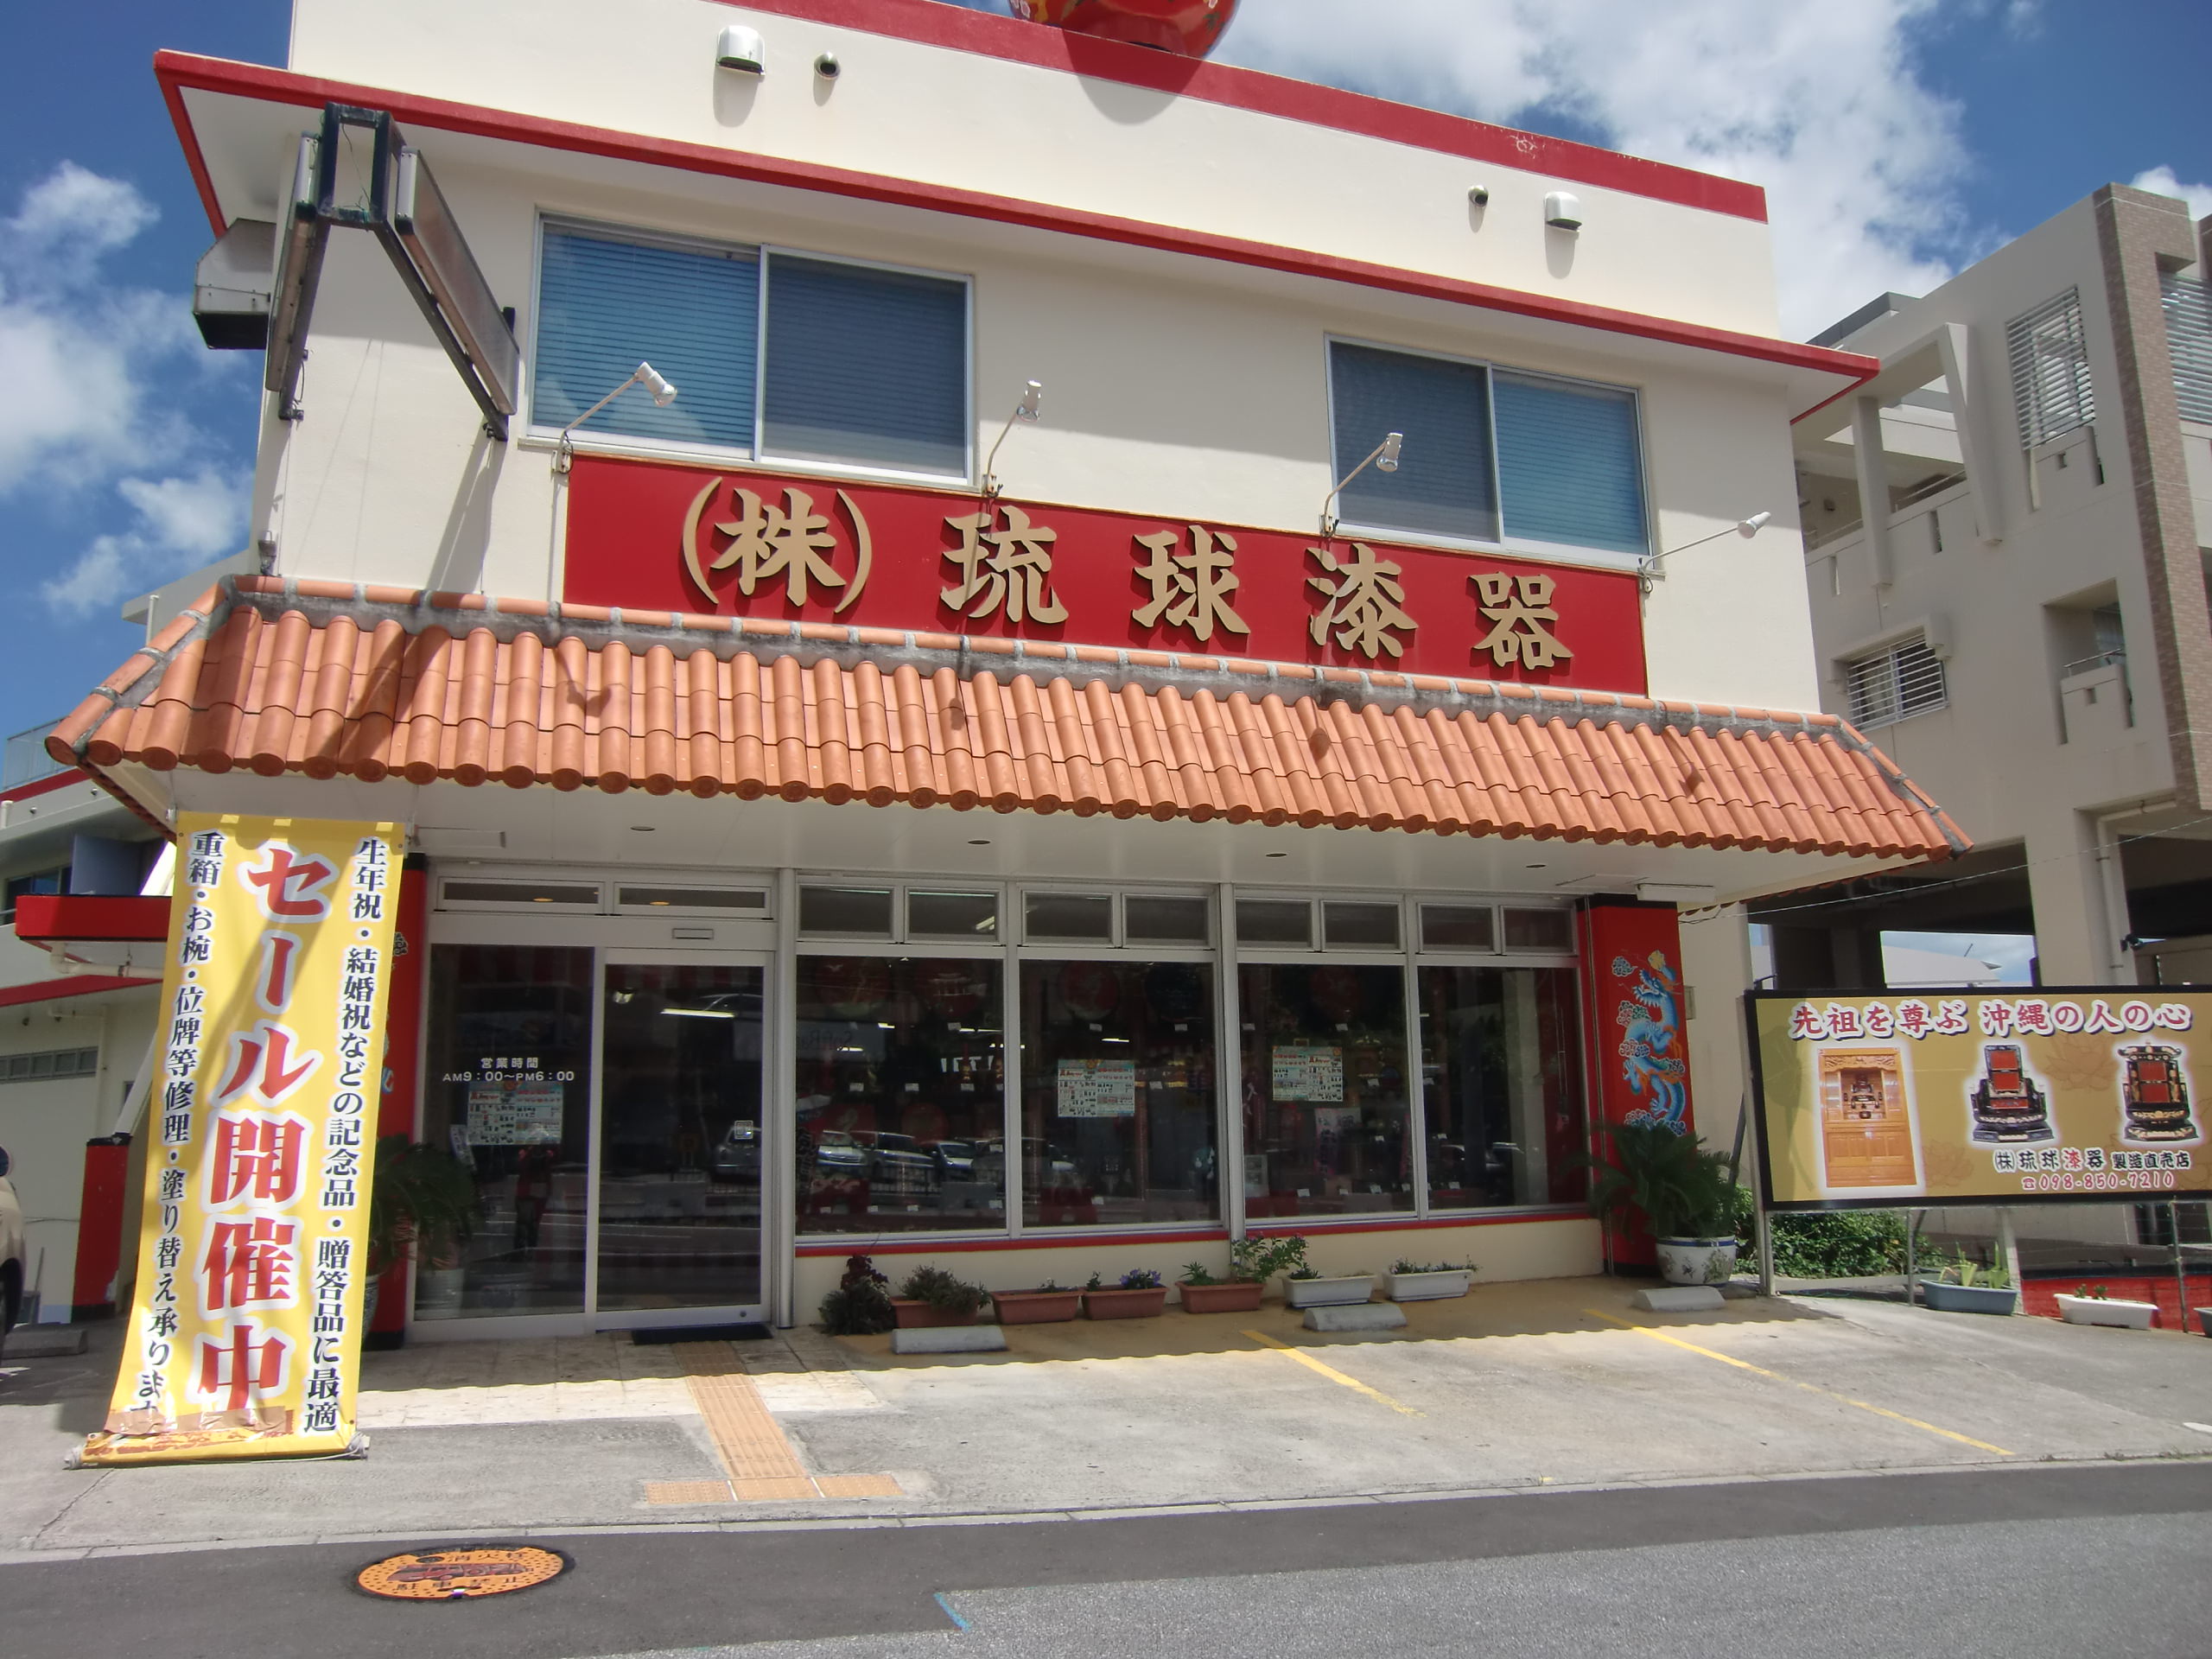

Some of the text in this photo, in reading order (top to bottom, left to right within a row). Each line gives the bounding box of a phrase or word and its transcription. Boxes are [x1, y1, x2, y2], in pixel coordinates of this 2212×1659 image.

[1792, 1001, 2190, 1036] 先祖を尊ぶ 沖縄の人の心
[480, 1057, 539, 1069] 営業時間
[197, 848, 331, 1410] セール開催中
[2113, 1151, 2190, 1169] 製造直売店
[2040, 1173, 2174, 1189] 098-850-7210
